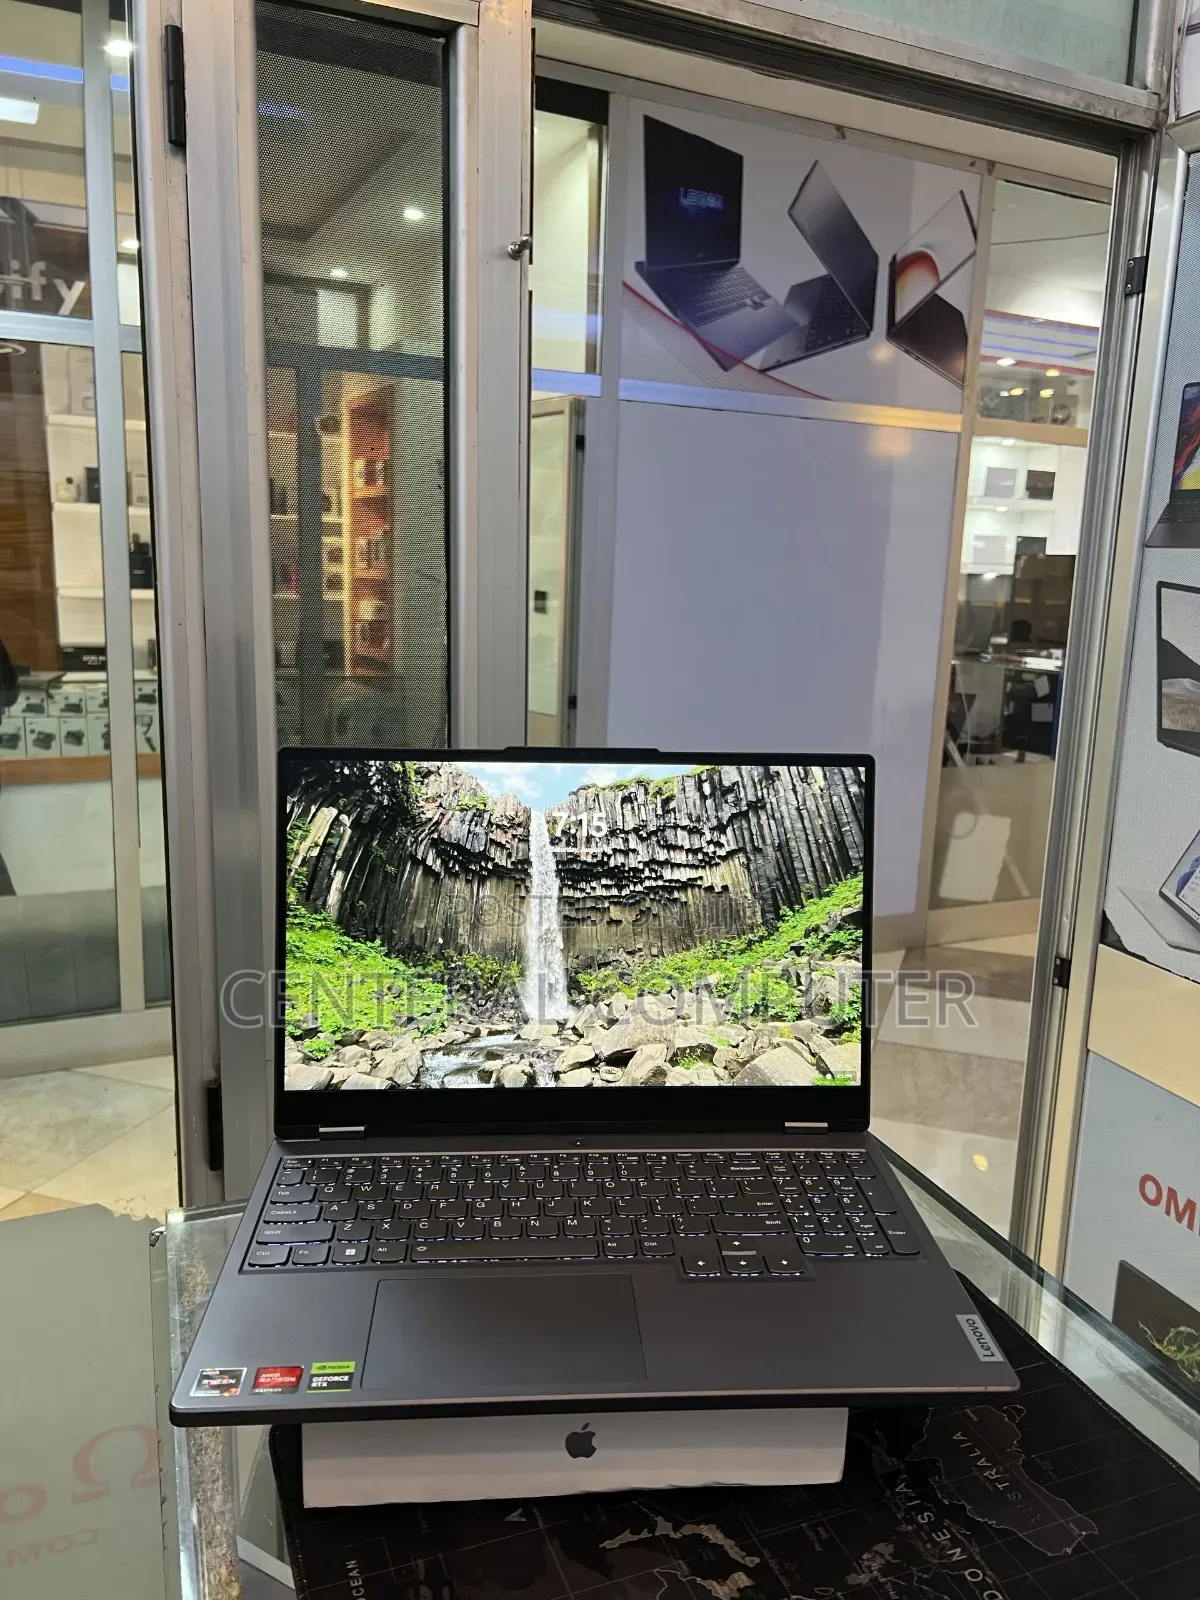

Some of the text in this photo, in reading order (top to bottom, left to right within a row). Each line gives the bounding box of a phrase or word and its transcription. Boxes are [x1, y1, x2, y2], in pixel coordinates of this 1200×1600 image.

[0, 259, 86, 316] ify
[552, 811, 608, 838] 7:15
[1138, 1173, 1200, 1237] OM
[965, 1318, 995, 1358] Lenovo
[952, 1431, 1042, 1525] AUSTRALIA
